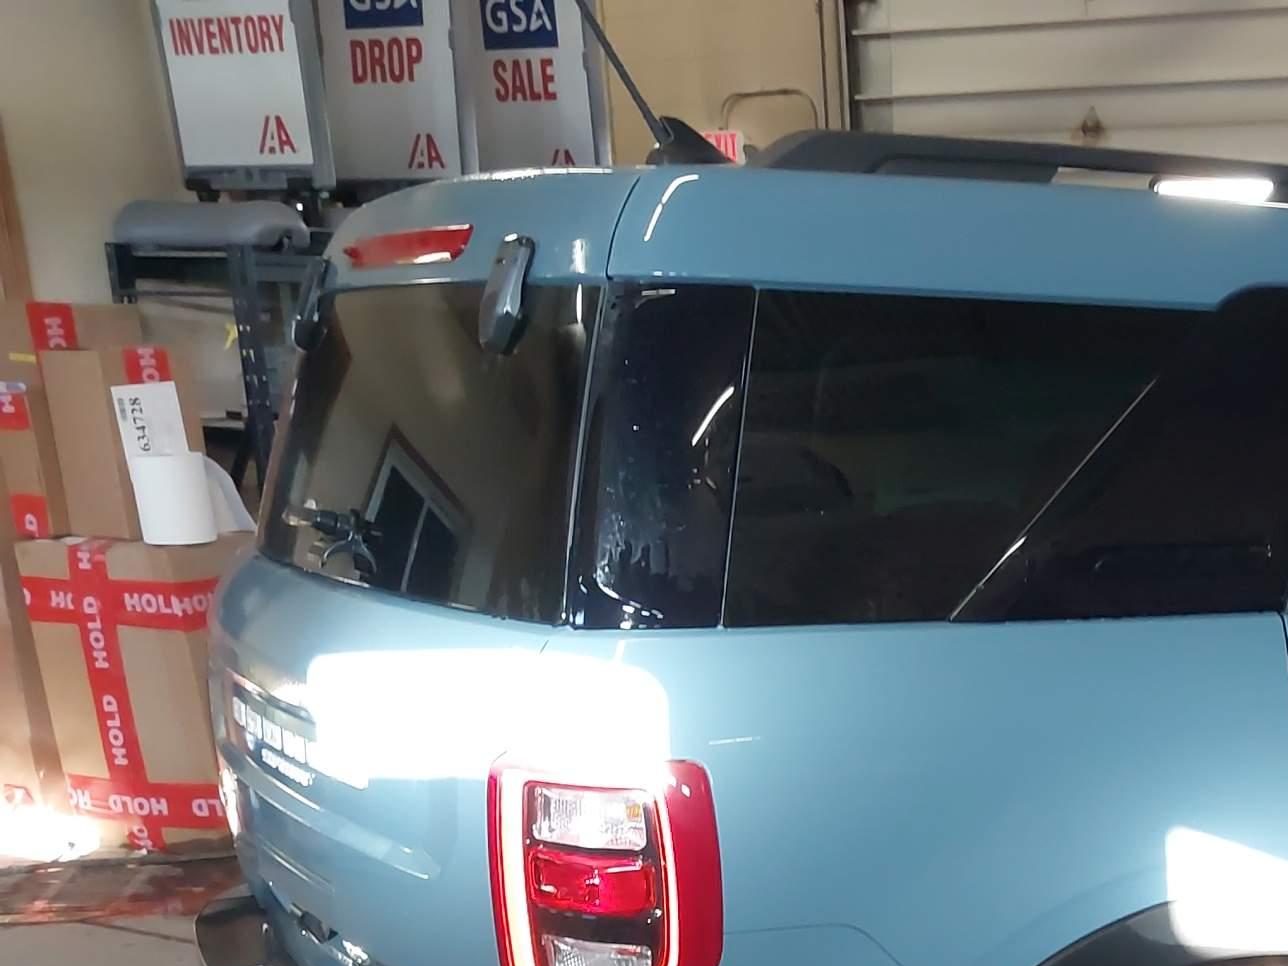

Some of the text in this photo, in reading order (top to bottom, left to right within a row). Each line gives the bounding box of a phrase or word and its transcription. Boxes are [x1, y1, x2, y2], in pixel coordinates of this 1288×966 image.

[169, 14, 285, 56] INVENTORY
[484, 0, 553, 34] GSA
[350, 37, 423, 84] DROP
[493, 58, 557, 103] SALE
[129, 397, 151, 452] 634728
[83, 596, 110, 669] HOLD
[102, 694, 129, 766] HOLD
[108, 794, 169, 816] HOLD
